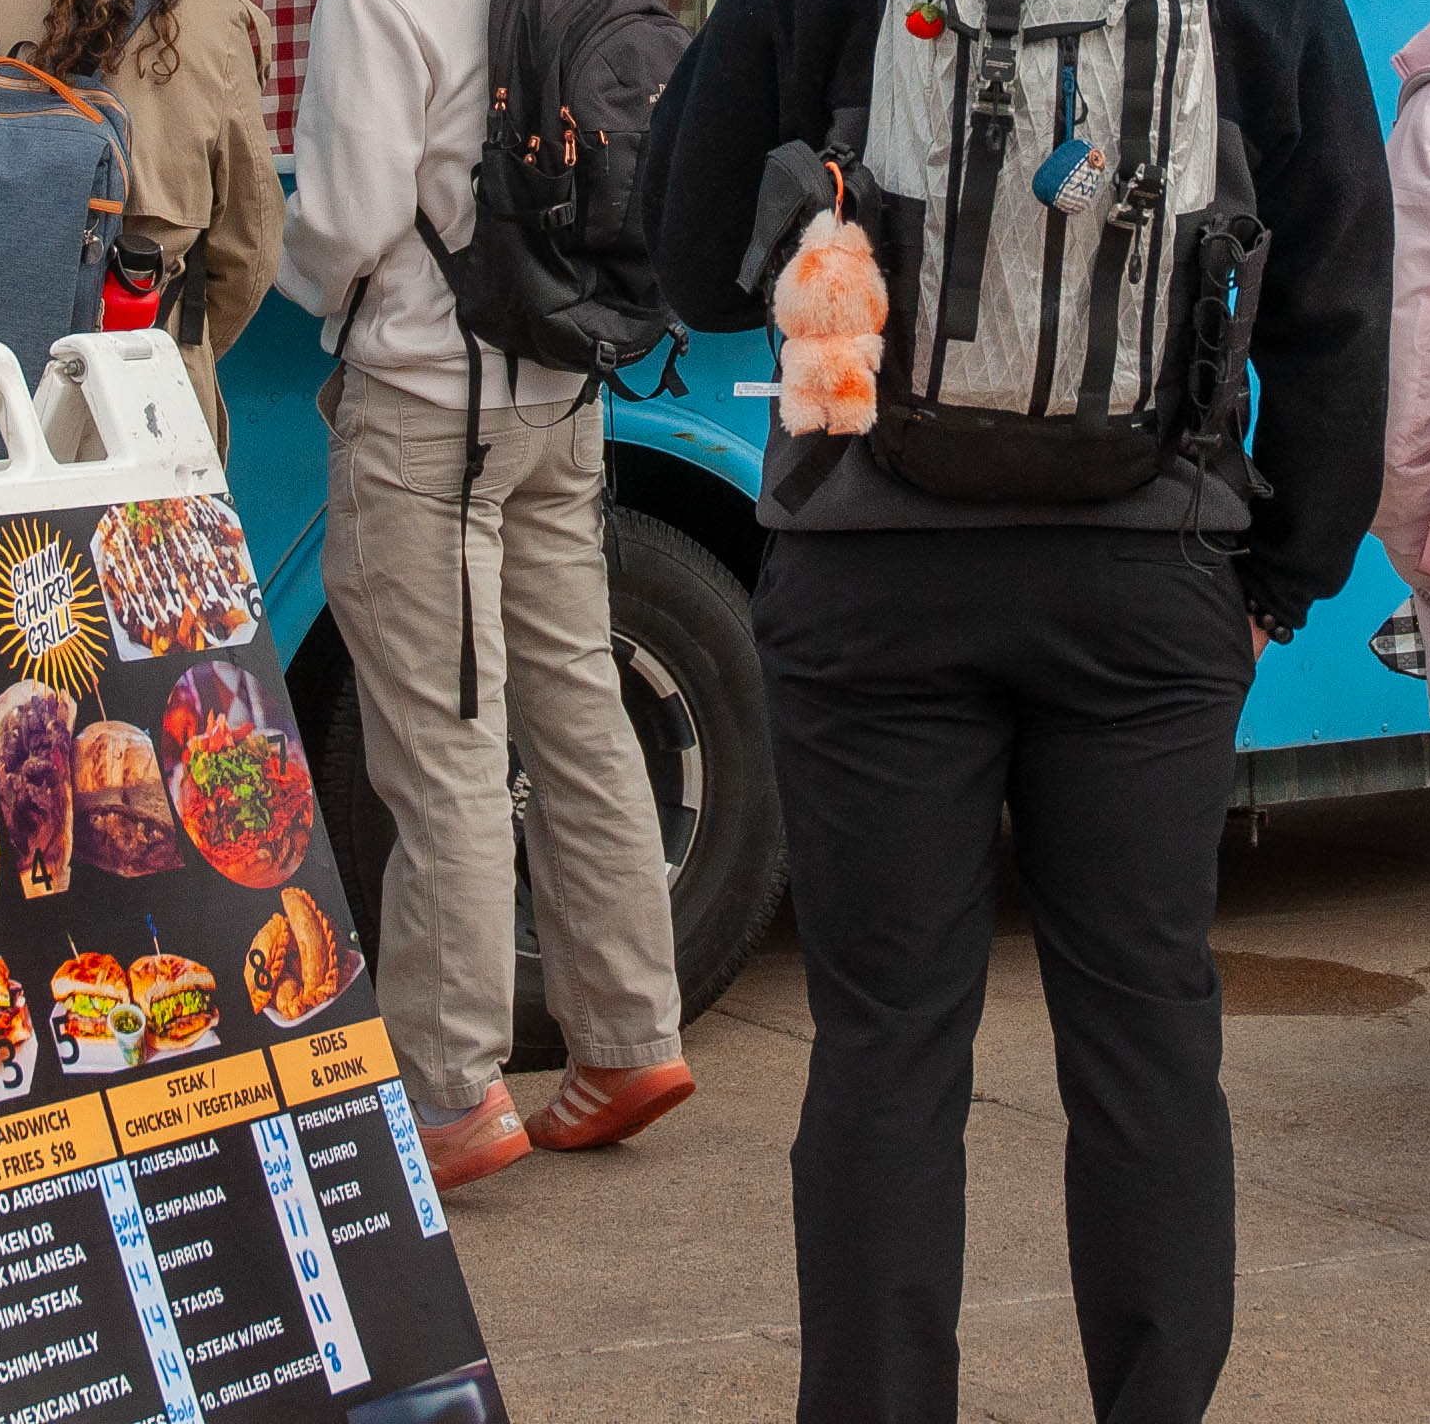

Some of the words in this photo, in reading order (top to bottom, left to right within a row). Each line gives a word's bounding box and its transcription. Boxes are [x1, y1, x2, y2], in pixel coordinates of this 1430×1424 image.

[11, 542, 62, 594] CHIMI
[13, 570, 73, 628] CHURRI
[247, 582, 264, 623] 6
[27, 613, 79, 658] GRILL
[267, 734, 286, 776] 7
[30, 848, 53, 891] 4
[248, 948, 271, 992] 8
[52, 1015, 80, 1066] 5
[309, 1031, 348, 1057] SIDES
[166, 1069, 209, 1098] STEAK
[311, 1069, 324, 1088] &
[324, 1056, 368, 1083] DRINK
[125, 1107, 183, 1138] CHICKEN
[193, 1082, 274, 1119] VEGETARIAN
[297, 1103, 345, 1132] FRENCH
[345, 1094, 379, 1117] FRIES
[258, 1118, 290, 1153] 14
[2, 1150, 45, 1180] FRIES
[50, 1140, 77, 1167] $18
[129, 1137, 221, 1179] 7.QUESADILLA
[309, 1140, 358, 1169] CHURRO
[12, 1168, 98, 1211] ARGENTINO
[103, 1162, 126, 1199] 14
[320, 1180, 362, 1207] WATER
[144, 1185, 227, 1225] 8.EMPANADA
[283, 1198, 309, 1238] 11
[31, 1221, 56, 1245] OR
[331, 1221, 366, 1245] SODA
[364, 1212, 392, 1233] CAN
[8, 1243, 88, 1285] MILANESA
[157, 1239, 214, 1272] BURRITO
[296, 1248, 320, 1283] 10
[128, 1261, 153, 1293] 14
[142, 1303, 168, 1337] 14
[171, 1301, 182, 1318] 3
[181, 1286, 225, 1316] TACOS
[309, 1292, 333, 1324] 11
[185, 1332, 239, 1366] 9.STEAK
[238, 1316, 285, 1347] W/RICE
[323, 1341, 342, 1373] 8
[158, 1349, 183, 1386] 14
[200, 1391, 221, 1412] 10.
[220, 1372, 272, 1404] GRILLED
[273, 1353, 323, 1385] CHEESE
[80, 1373, 134, 1408] TORTA
